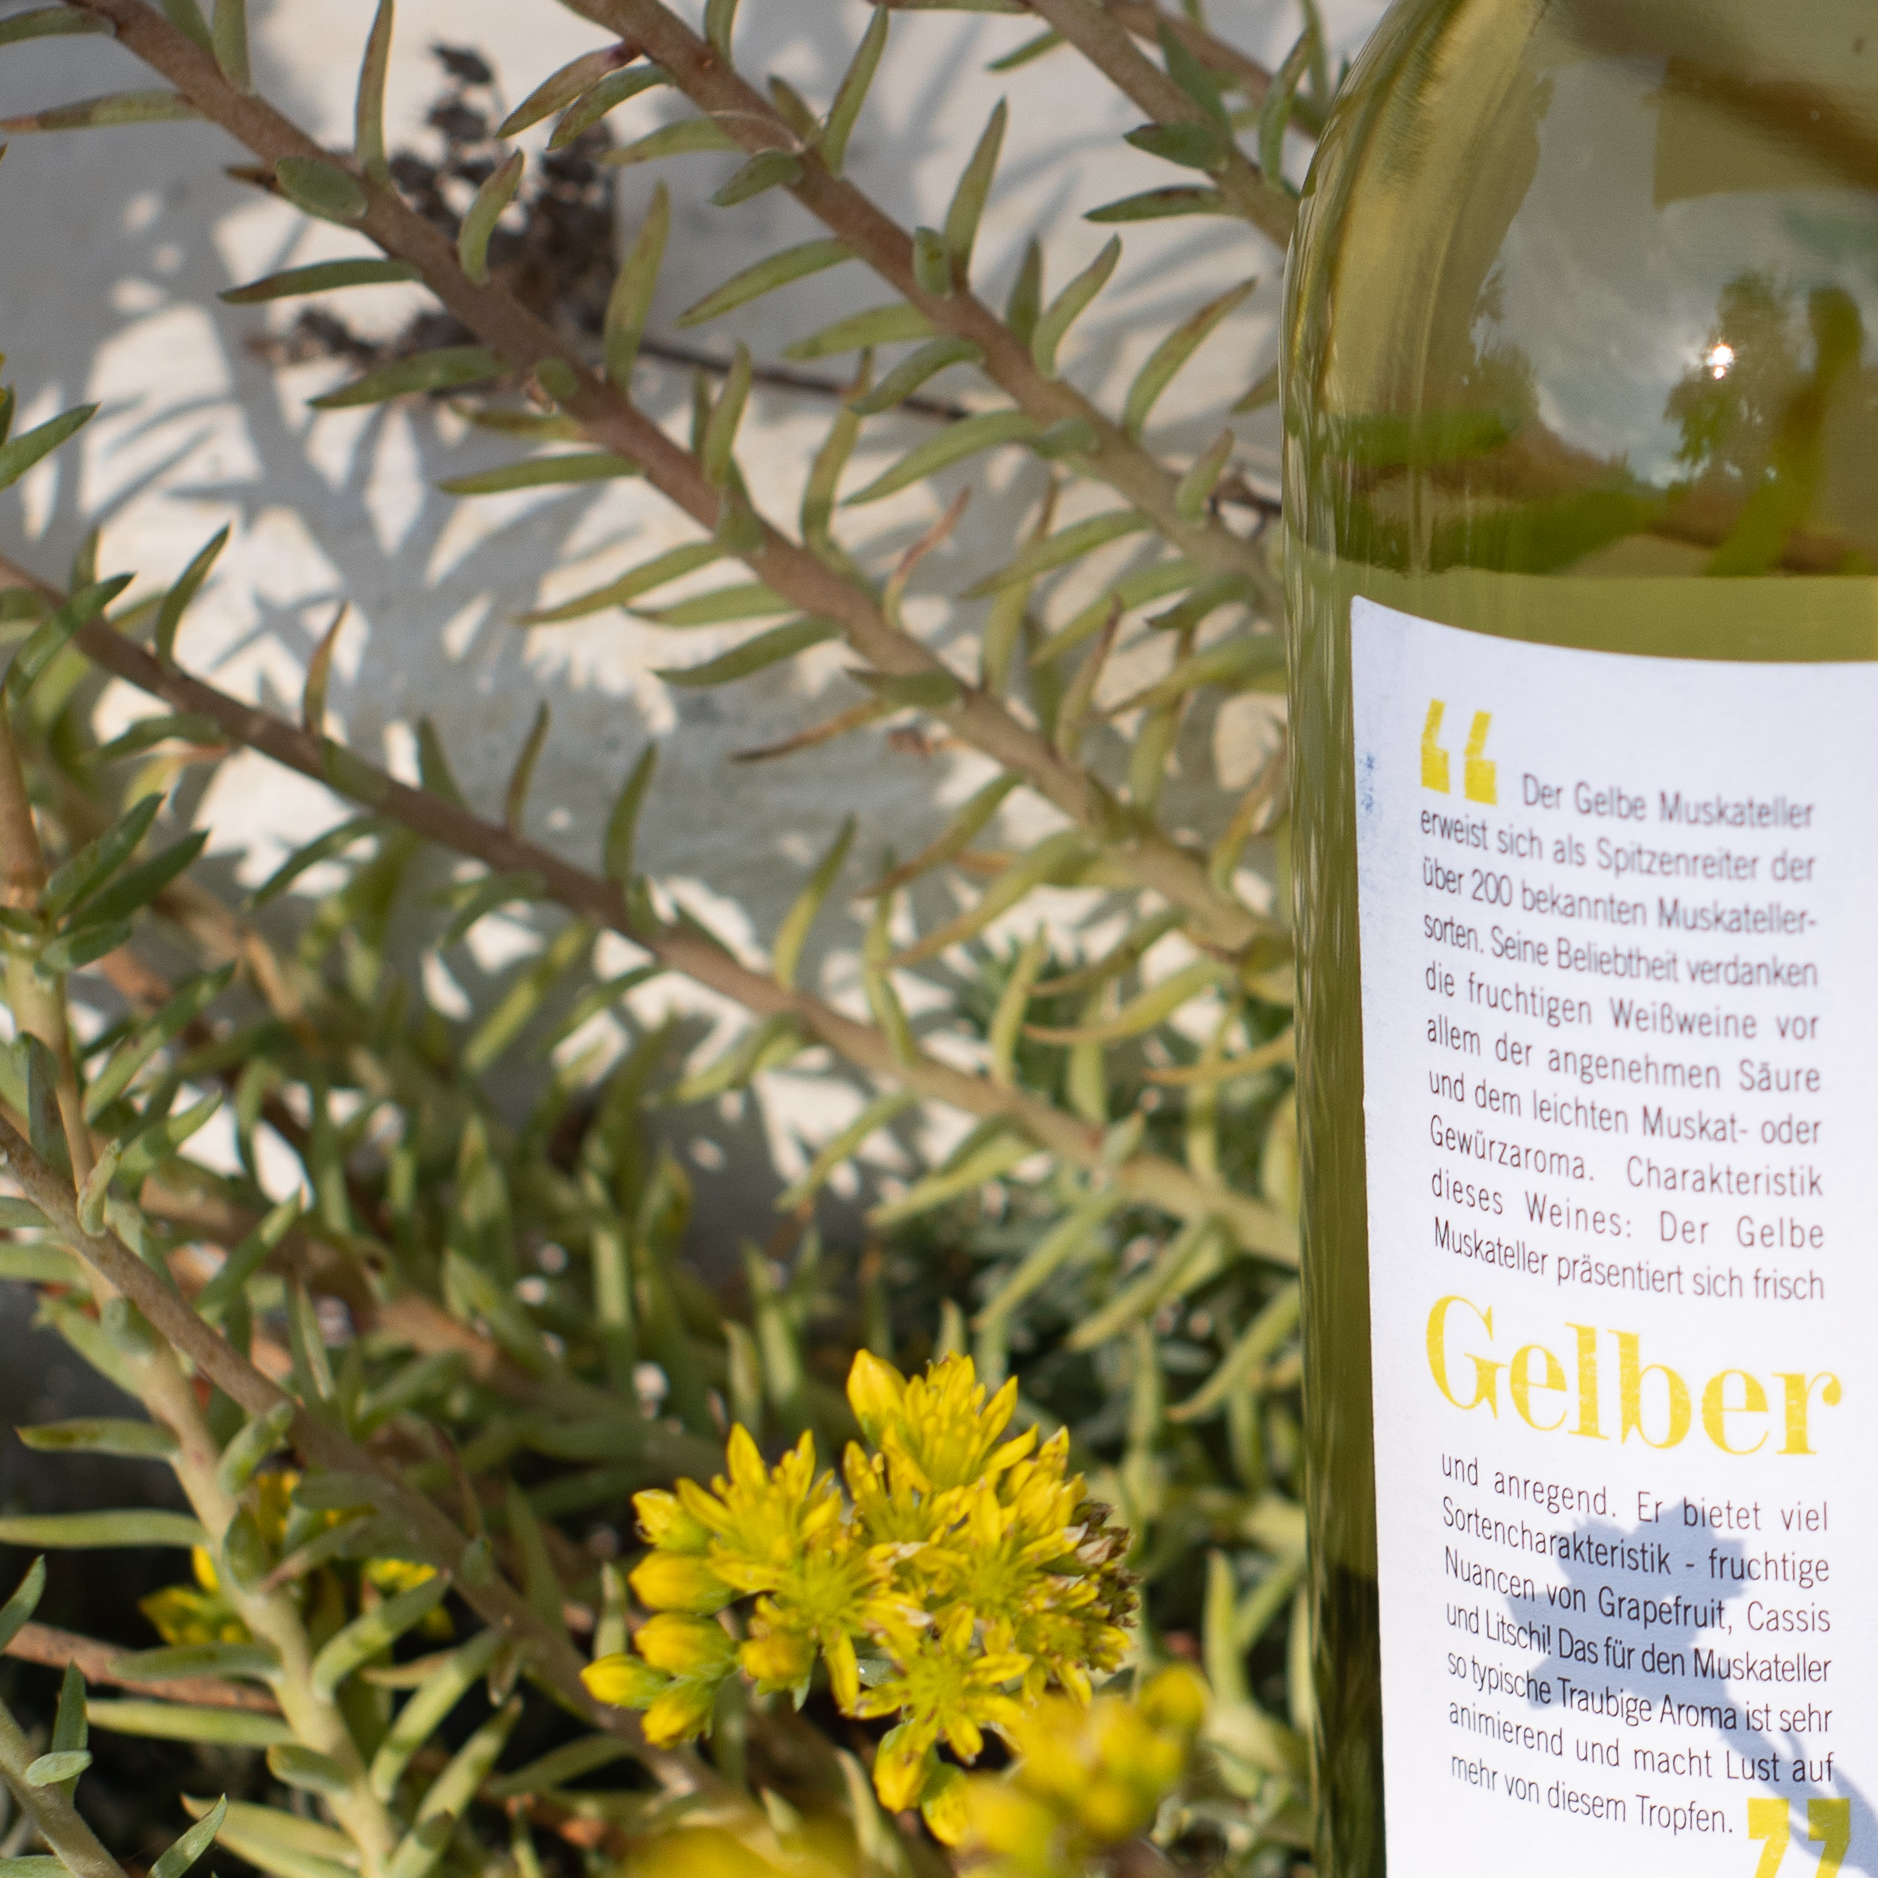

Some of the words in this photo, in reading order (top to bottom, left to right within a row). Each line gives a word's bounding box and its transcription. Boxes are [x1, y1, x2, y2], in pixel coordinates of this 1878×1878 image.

[1523, 773, 1562, 808] Der
[1574, 782, 1646, 821] Gelbe
[1659, 791, 1814, 828] Muskateller
[1421, 809, 1488, 851] erweist
[1499, 824, 1543, 859] sich
[1553, 837, 1586, 867] als
[1598, 838, 1759, 880] Spitzenreiter
[1772, 851, 1815, 881] der
[1423, 856, 1463, 895] über
[1472, 869, 1512, 906] 200
[1522, 880, 1646, 925] bekannten
[1659, 898, 1817, 933] Muskateller-
[1424, 913, 1483, 953] sorten.
[1491, 926, 1548, 965] Seine
[1558, 937, 1679, 982] Beliebtheit
[1688, 955, 1818, 987] verdanken
[1425, 961, 1455, 996] die
[1468, 973, 1591, 1028] fruchtigen
[1610, 997, 1757, 1039] Weißweine
[1776, 1014, 1819, 1040] vor
[1428, 1015, 1480, 1056] allem
[1495, 1033, 1533, 1067] der
[1548, 1046, 1720, 1089] angenehmen
[1739, 1059, 1820, 1092] Säure
[1429, 1069, 1464, 1103] und
[1474, 1079, 1520, 1117] dem
[1533, 1090, 1628, 1134] leichten
[1643, 1105, 1748, 1143] Muskat-
[1761, 1114, 1820, 1144] oder
[1430, 1114, 1594, 1181] Gewürzaroma.
[1627, 1155, 1822, 1196] Charakteristik
[1432, 1168, 1503, 1215] dieses
[1525, 1190, 1631, 1237] Weines:
[1660, 1211, 1709, 1243] Der
[1737, 1216, 1824, 1248] Gelbe
[1435, 1217, 1548, 1276] Muskateller
[1558, 1254, 1683, 1294] präsentiert
[1693, 1265, 1742, 1297] sich
[1754, 1268, 1824, 1300] frisch
[1426, 1294, 1843, 1455] Gelber
[1442, 1453, 1478, 1487] und
[1494, 1471, 1616, 1516] anregend.
[1638, 1491, 1663, 1522] Er
[1684, 1497, 1761, 1531] bietet
[1781, 1501, 1829, 1531] viel
[1442, 1496, 1671, 1575] Sortencharakteristik
[1709, 1548, 1829, 1589] fruchtige
[1445, 1545, 1535, 1599] Nuancen
[1546, 1583, 1586, 1612] von
[1599, 1586, 1733, 1635] Grapefruit,
[1748, 1601, 1830, 1633] Cassis
[1446, 1601, 1479, 1635] und
[1487, 1612, 1551, 1655] Litschi!
[1559, 1627, 1598, 1664] Das
[1604, 1636, 1635, 1671] für
[1642, 1642, 1684, 1676] den
[1694, 1648, 1832, 1682] Muskateller
[1448, 1651, 1466, 1678] so
[1471, 1656, 1551, 1705] typische
[1557, 1677, 1651, 1726] Traubige
[1661, 1695, 1736, 1729] Aroma
[1746, 1701, 1772, 1732] ist
[1779, 1702, 1832, 1733] sehr
[1449, 1701, 1562, 1756] animierend
[1576, 1736, 1619, 1767] und
[1634, 1746, 1712, 1778] macht
[1726, 1750, 1780, 1782] Lust
[1792, 1752, 1834, 1783] auf
[1451, 1754, 1497, 1792] mehr
[1504, 1773, 1539, 1804] von
[1548, 1780, 1626, 1822] diesem
[1635, 1794, 1733, 1835] Tropfen.
